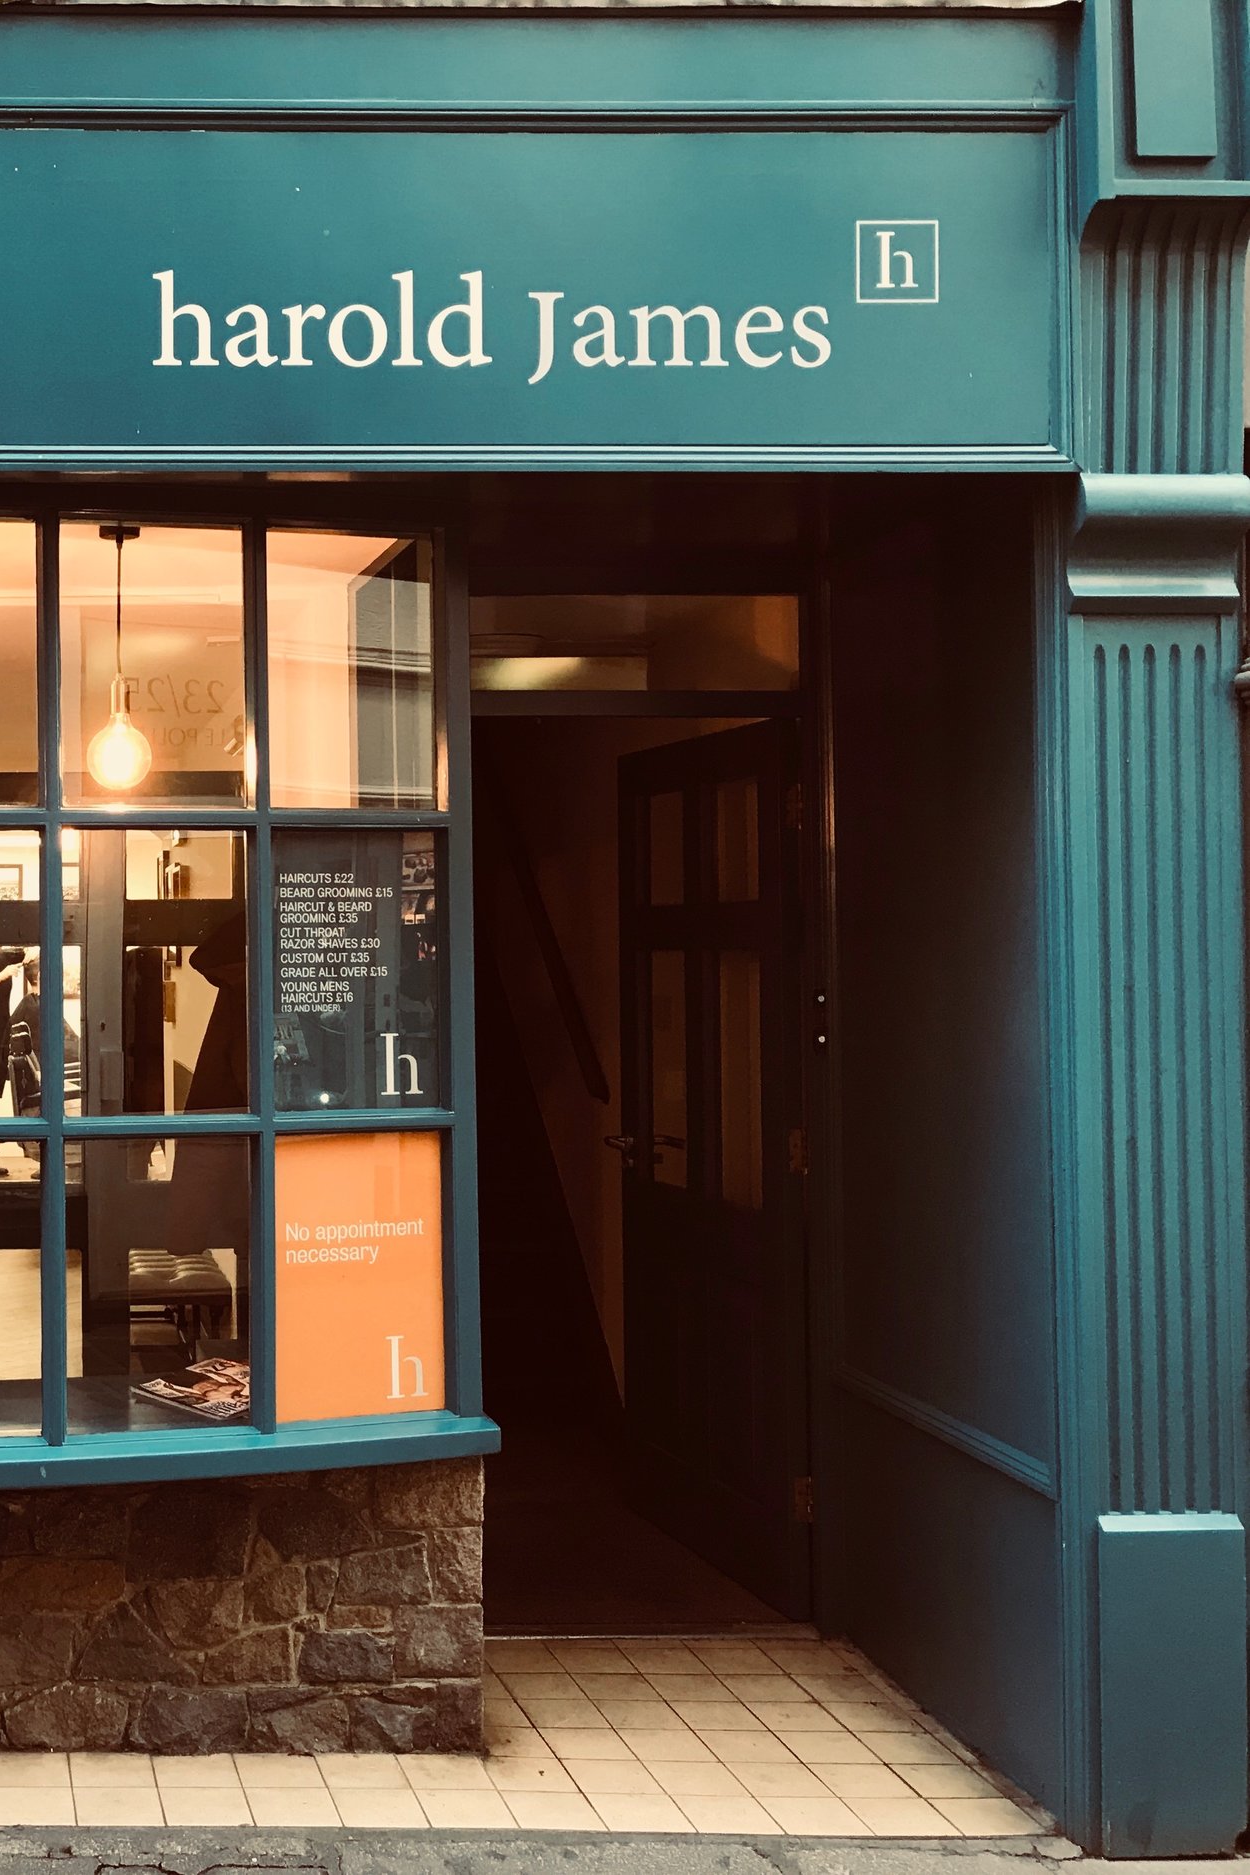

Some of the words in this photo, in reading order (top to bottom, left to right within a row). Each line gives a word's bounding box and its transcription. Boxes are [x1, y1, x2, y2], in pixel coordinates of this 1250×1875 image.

[876, 231, 919, 289] h
[152, 269, 493, 368] harold
[527, 290, 832, 385] James
[279, 873, 332, 884] HAIRCUTS
[334, 873, 354, 884] £22
[279, 887, 315, 898] BEARD
[317, 887, 373, 898] GROOMING
[375, 887, 393, 898] £15
[280, 901, 326, 912] HAIRCUT
[328, 901, 335, 912] &
[337, 901, 372, 912] BEARD
[280, 913, 336, 924] GROOMING
[338, 913, 358, 924] £35
[280, 927, 302, 938] CUT
[304, 927, 344, 938] THROAT
[280, 938, 316, 949] RAZOR
[317, 938, 358, 949] SHAVES
[360, 938, 381, 949] £30
[280, 952, 324, 963] CUSTOM
[326, 952, 348, 963] CUT
[350, 952, 370, 963] £35
[280, 966, 316, 978] GRADE
[318, 966, 337, 978] ALL
[340, 966, 368, 978] OVER
[370, 966, 388, 978] £15
[281, 981, 318, 992] YOUNG
[320, 981, 350, 992] MENS
[281, 992, 333, 1003] HAIRCUTS
[335, 992, 354, 1003] £16
[281, 1004, 292, 1013] (13
[294, 1004, 310, 1013] AND
[311, 1004, 341, 1013] UNDER)
[379, 1032, 424, 1096] h
[285, 1222, 310, 1242] No
[315, 1218, 424, 1244] appointment
[285, 1245, 379, 1265] necessary
[385, 1335, 429, 1399] h
